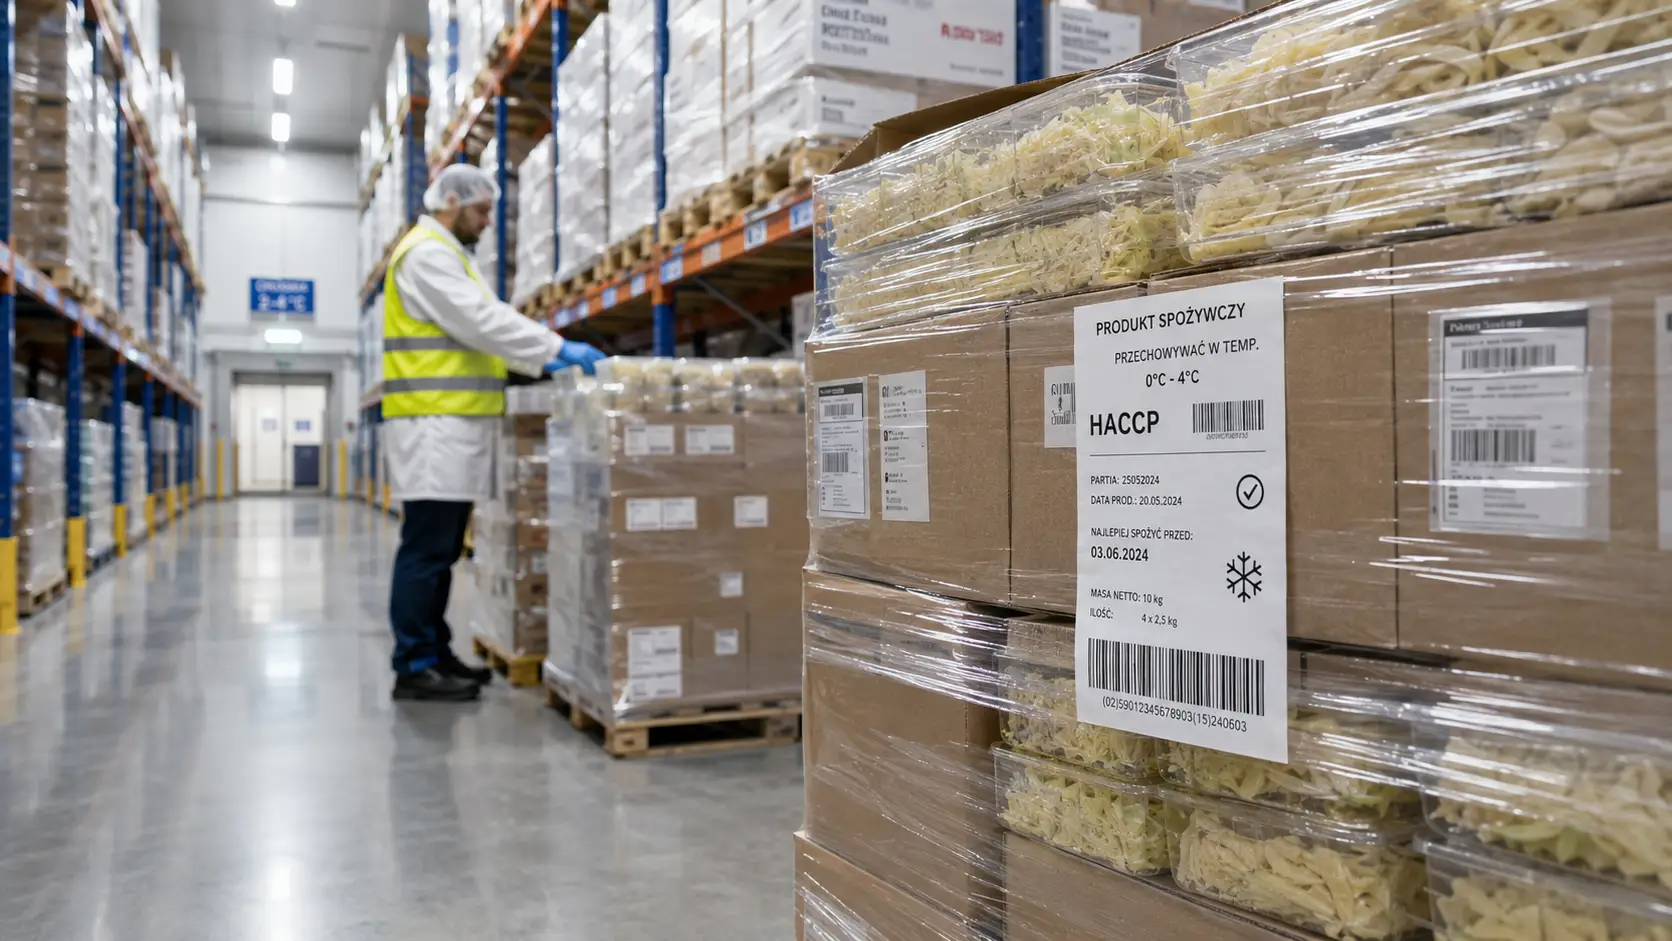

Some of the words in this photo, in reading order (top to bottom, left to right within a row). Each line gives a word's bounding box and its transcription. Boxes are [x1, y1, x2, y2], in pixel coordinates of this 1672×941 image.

[1096, 315, 1155, 336] PRODUKT
[1159, 303, 1246, 328] SPOŻYWCZY
[1115, 341, 1206, 364] PRZECHOWYWAĆ
[1209, 342, 1221, 355] W
[1223, 338, 1260, 354] TEMP.
[1145, 372, 1167, 388] 0°C
[1178, 370, 1200, 385] 4°C
[1089, 410, 1160, 436] HACCP
[1090, 475, 1120, 485] PARTIA:
[1121, 475, 1160, 485] 25052024
[1090, 495, 1110, 505] DATA
[1111, 495, 1138, 506] PROD.:
[1139, 495, 1183, 506] 20.05.2024
[1090, 527, 1129, 538] NAJLEPIEJ
[1131, 527, 1162, 539] SPOŻYĆ
[1163, 529, 1194, 541] PRZED:
[1090, 545, 1149, 562] 03.06.2024
[1090, 588, 1111, 599] MASA
[1113, 590, 1142, 602] NETTO:
[1143, 593, 1153, 603] 10
[1153, 594, 1164, 607] kg
[1141, 613, 1147, 623] 4
[1148, 616, 1153, 624] x
[1154, 614, 1167, 626] 2,5
[1167, 616, 1178, 628] kg
[1102, 695, 1248, 733] (02)59012345678903(15)240603
